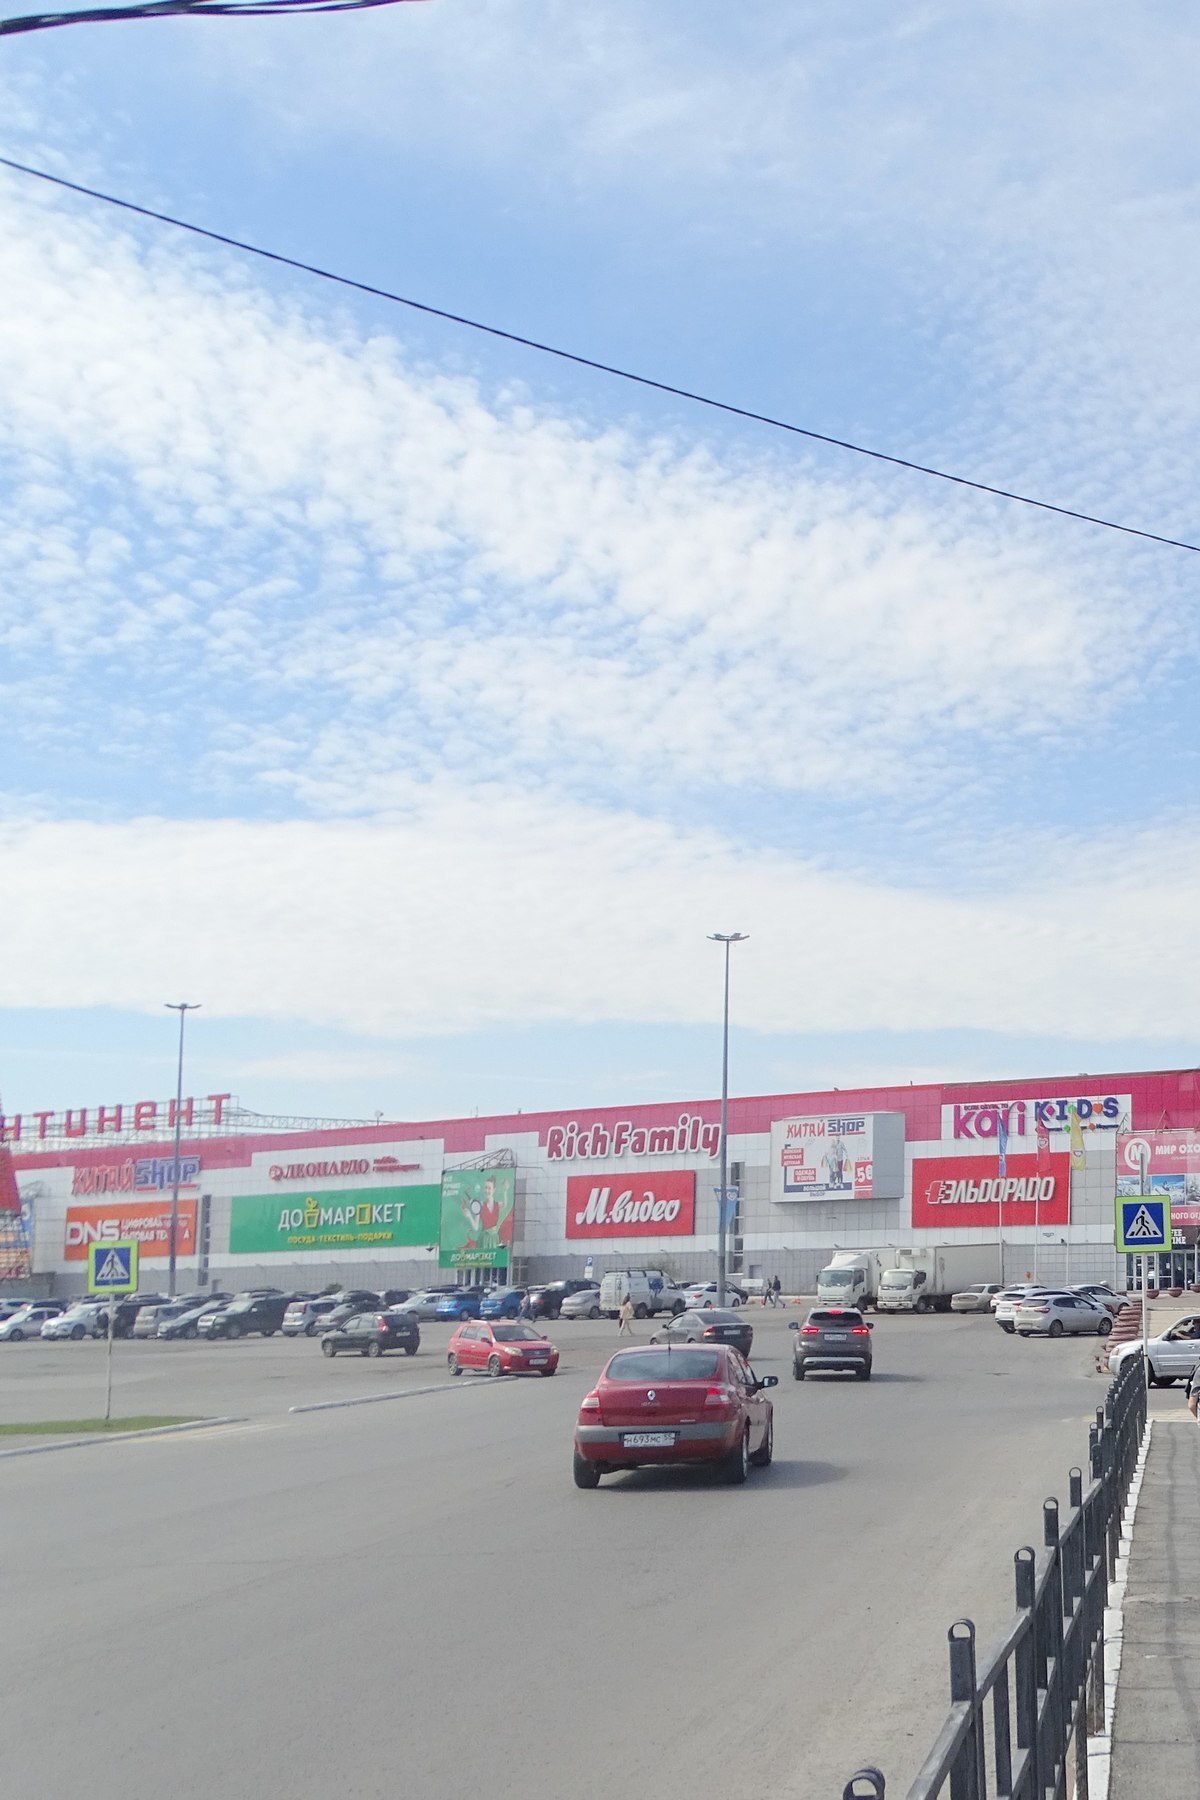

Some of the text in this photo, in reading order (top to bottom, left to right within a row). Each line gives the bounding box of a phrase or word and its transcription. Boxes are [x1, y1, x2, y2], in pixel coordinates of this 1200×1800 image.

[786, 1119, 825, 1138] КИТАЙ
[954, 1097, 1119, 1139] kari KIDS
[548, 1113, 722, 1160] Rich Family
[1155, 1145, 1177, 1155] МИР
[575, 1187, 682, 1226] М.видео
[66, 1219, 120, 1246] DNS
